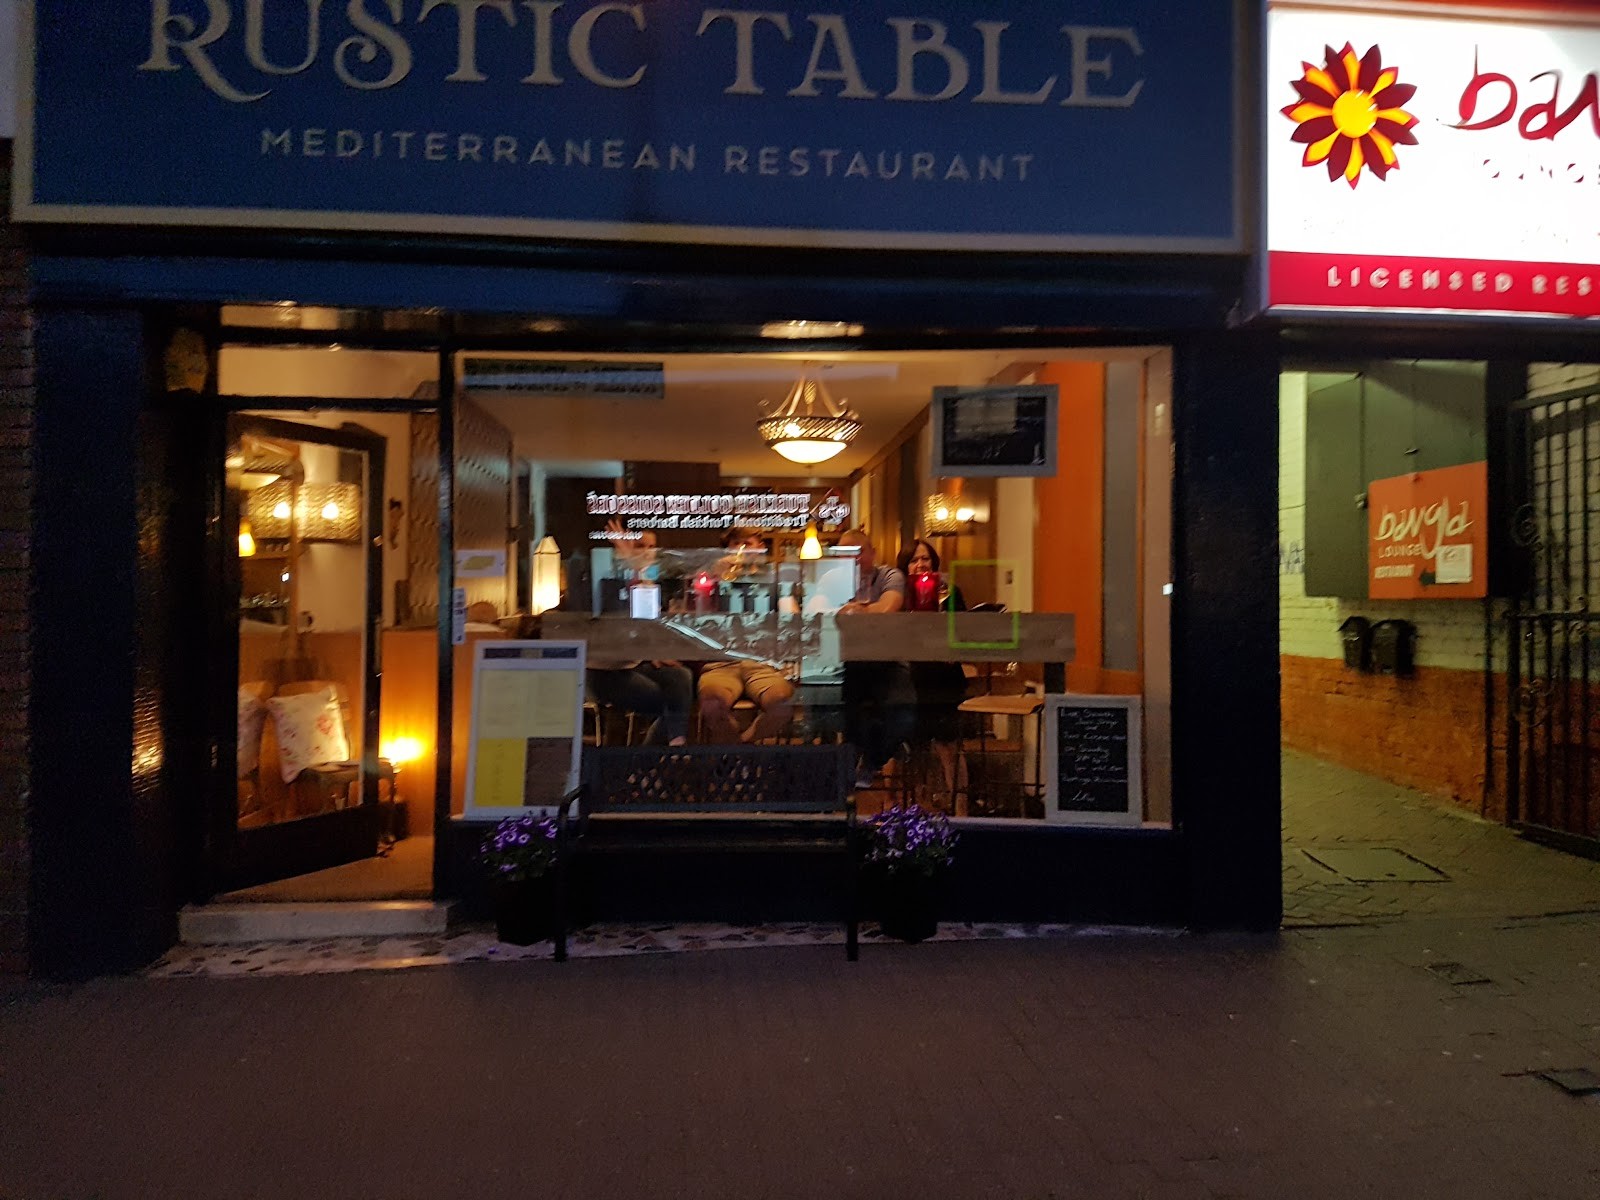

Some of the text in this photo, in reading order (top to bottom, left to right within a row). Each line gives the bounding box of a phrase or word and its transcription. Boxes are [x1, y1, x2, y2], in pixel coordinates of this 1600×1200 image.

[137, 0, 1145, 108] RUSTIC TABLE
[260, 127, 1036, 182] MEDITERRANEAN RESTAURANT
[1326, 265, 1514, 294] LICENSED
